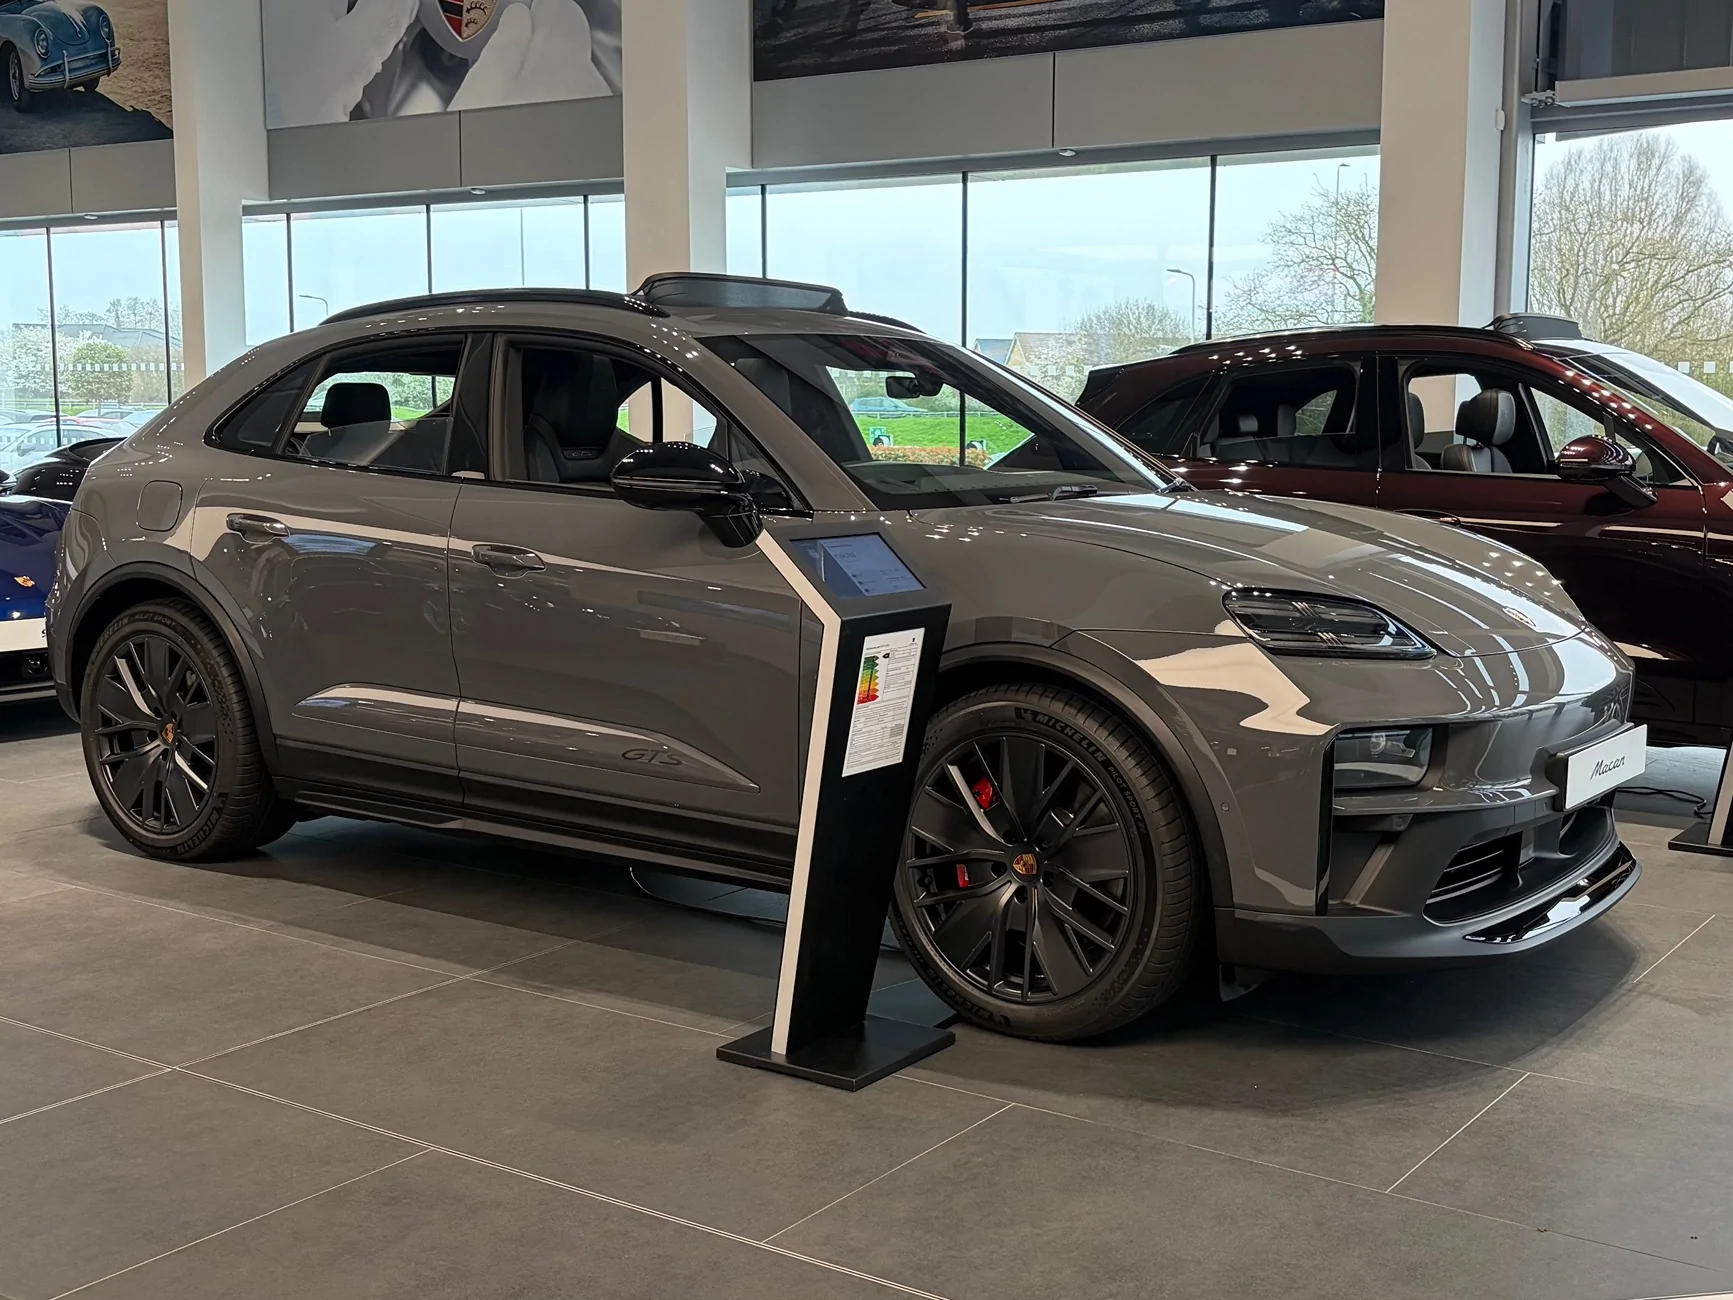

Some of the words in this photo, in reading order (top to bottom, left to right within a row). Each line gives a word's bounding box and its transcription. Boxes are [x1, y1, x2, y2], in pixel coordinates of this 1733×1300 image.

[621, 748, 683, 766] GTS
[1035, 715, 1106, 762] MICHELIN
[1107, 766, 1126, 791] PILOT
[1124, 790, 1142, 820] SPORT
[1590, 756, 1626, 780] Macan
